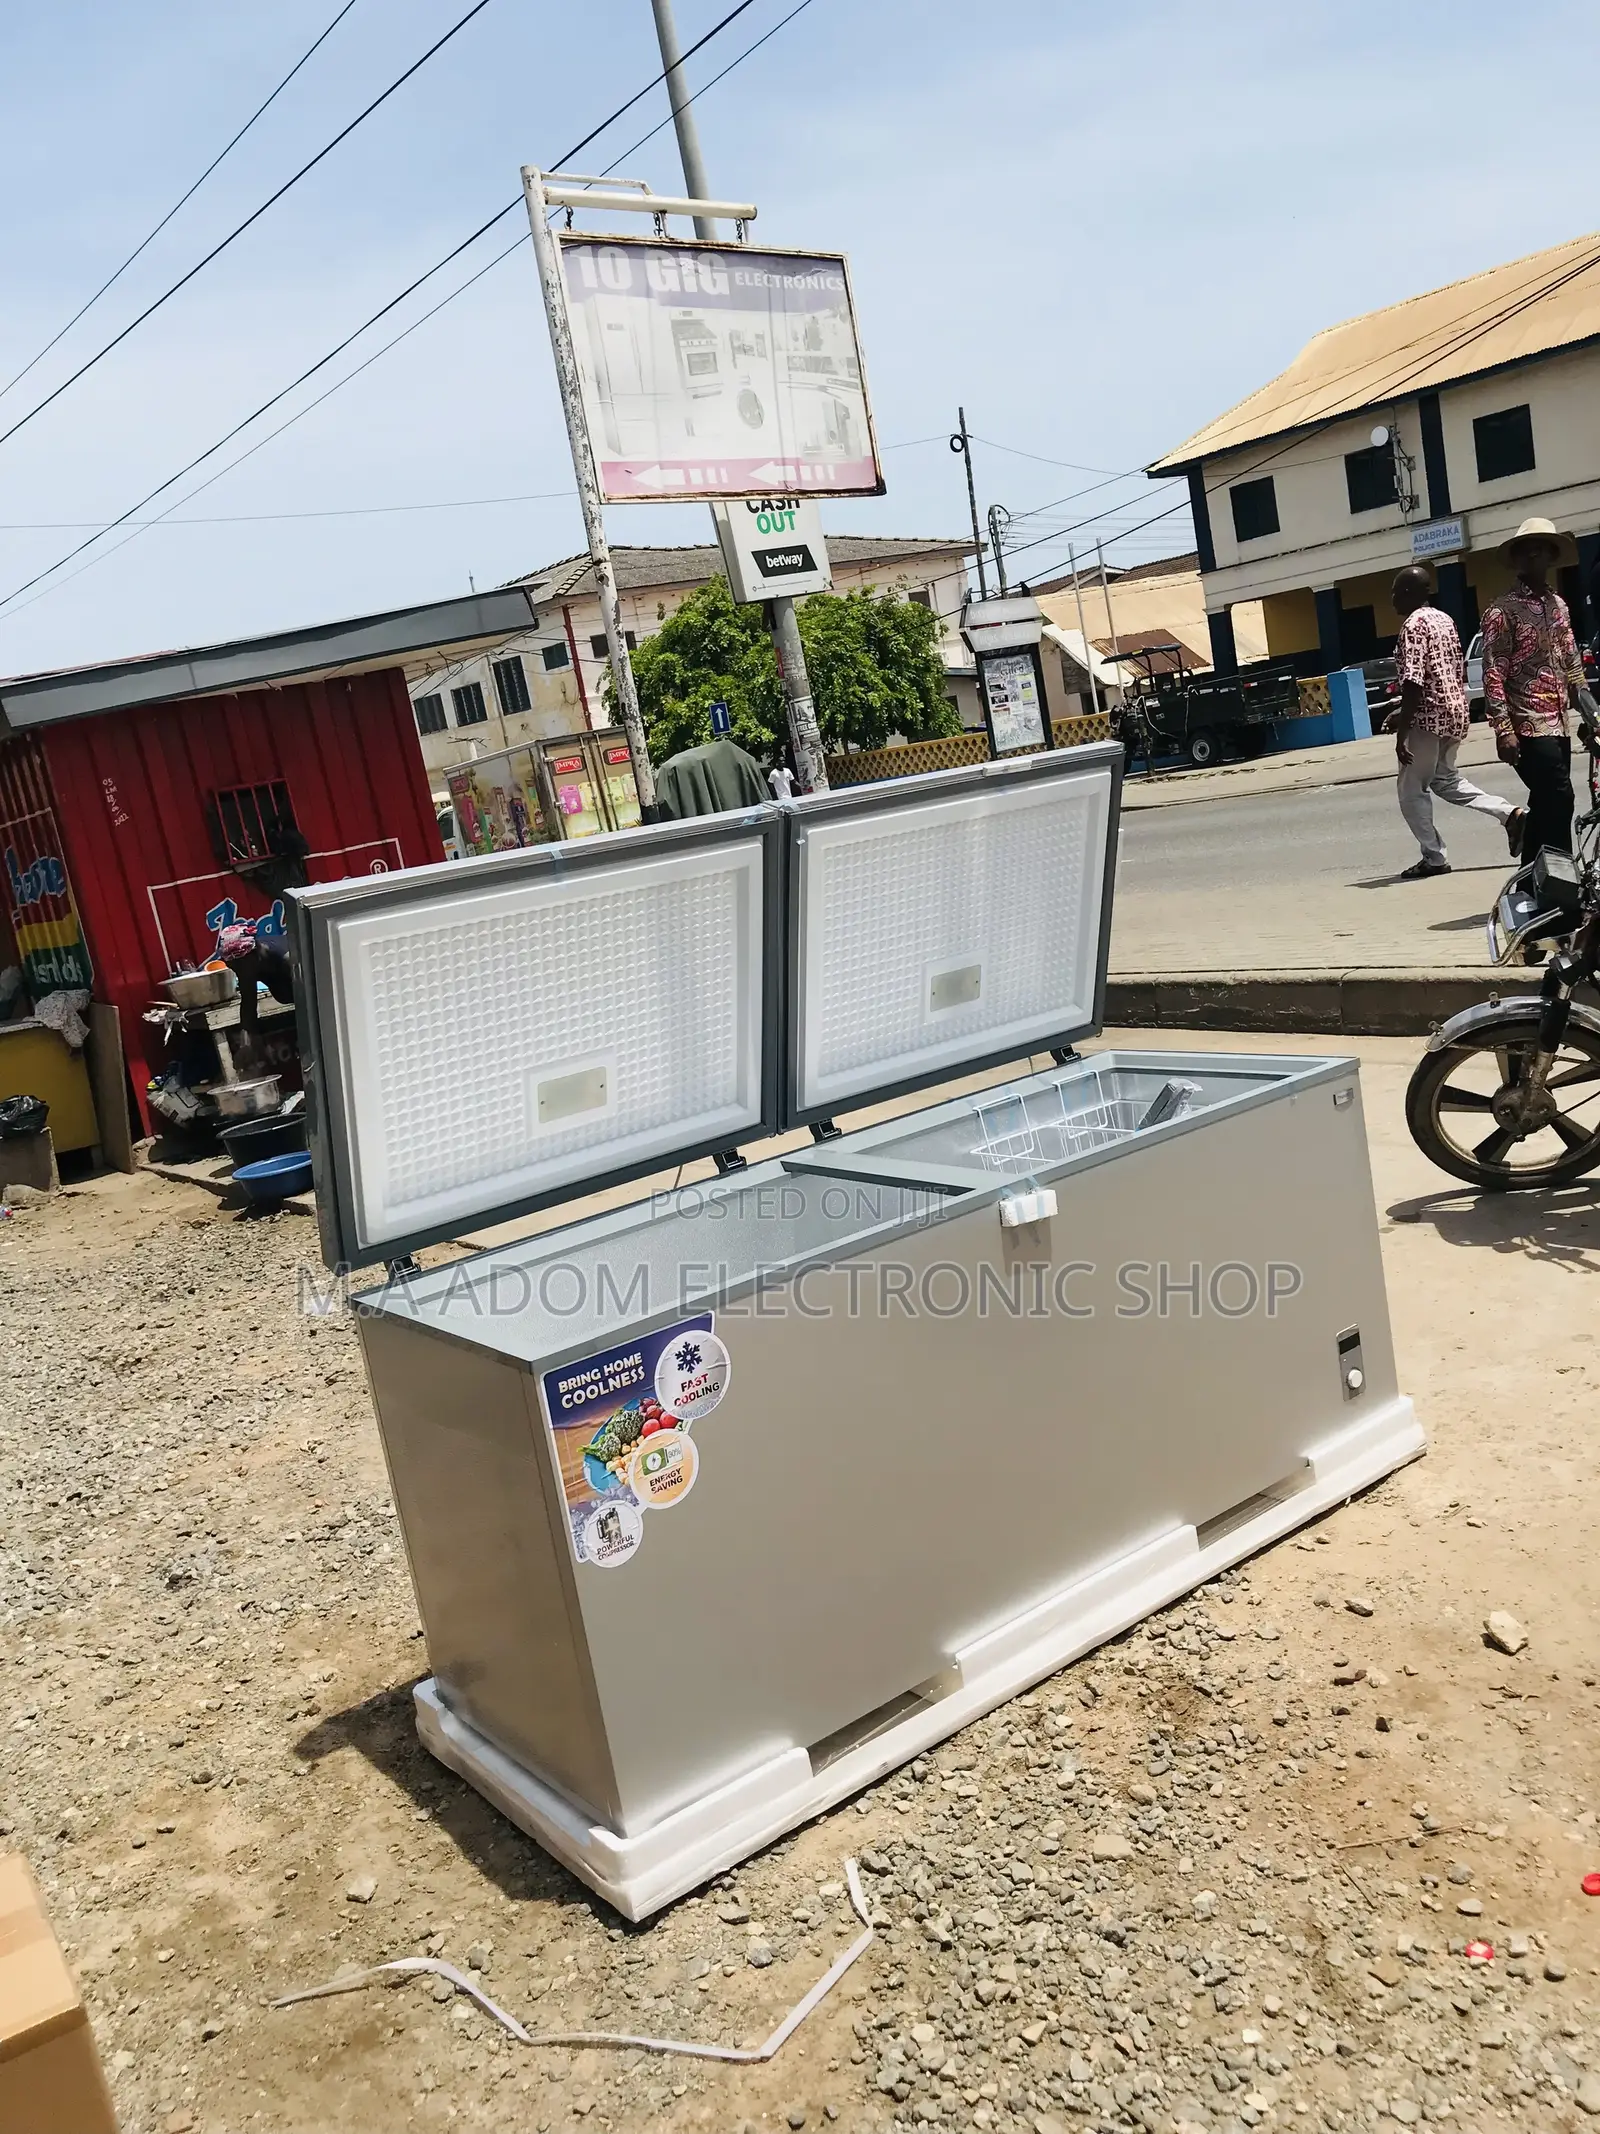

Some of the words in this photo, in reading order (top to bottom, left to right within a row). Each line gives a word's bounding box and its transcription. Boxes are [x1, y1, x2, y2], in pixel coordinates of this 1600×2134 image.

[570, 246, 632, 290] 10
[734, 272, 844, 291] ELECTRONICS
[756, 511, 796, 534] OUT
[1414, 526, 1460, 544] ADABRAKA
[765, 554, 803, 568] betway
[555, 759, 580, 770] IMPRA
[558, 1368, 602, 1394] BRING
[603, 1352, 643, 1377] HOME
[681, 1373, 709, 1392] FAST
[561, 1365, 646, 1409] COOLNESS
[674, 1382, 720, 1407] COOLING
[650, 1467, 682, 1487] ENERGY
[651, 1475, 684, 1495] SAVING
[597, 1534, 635, 1554] POWERFUL
[598, 1540, 635, 1561] COMPRESSOR
